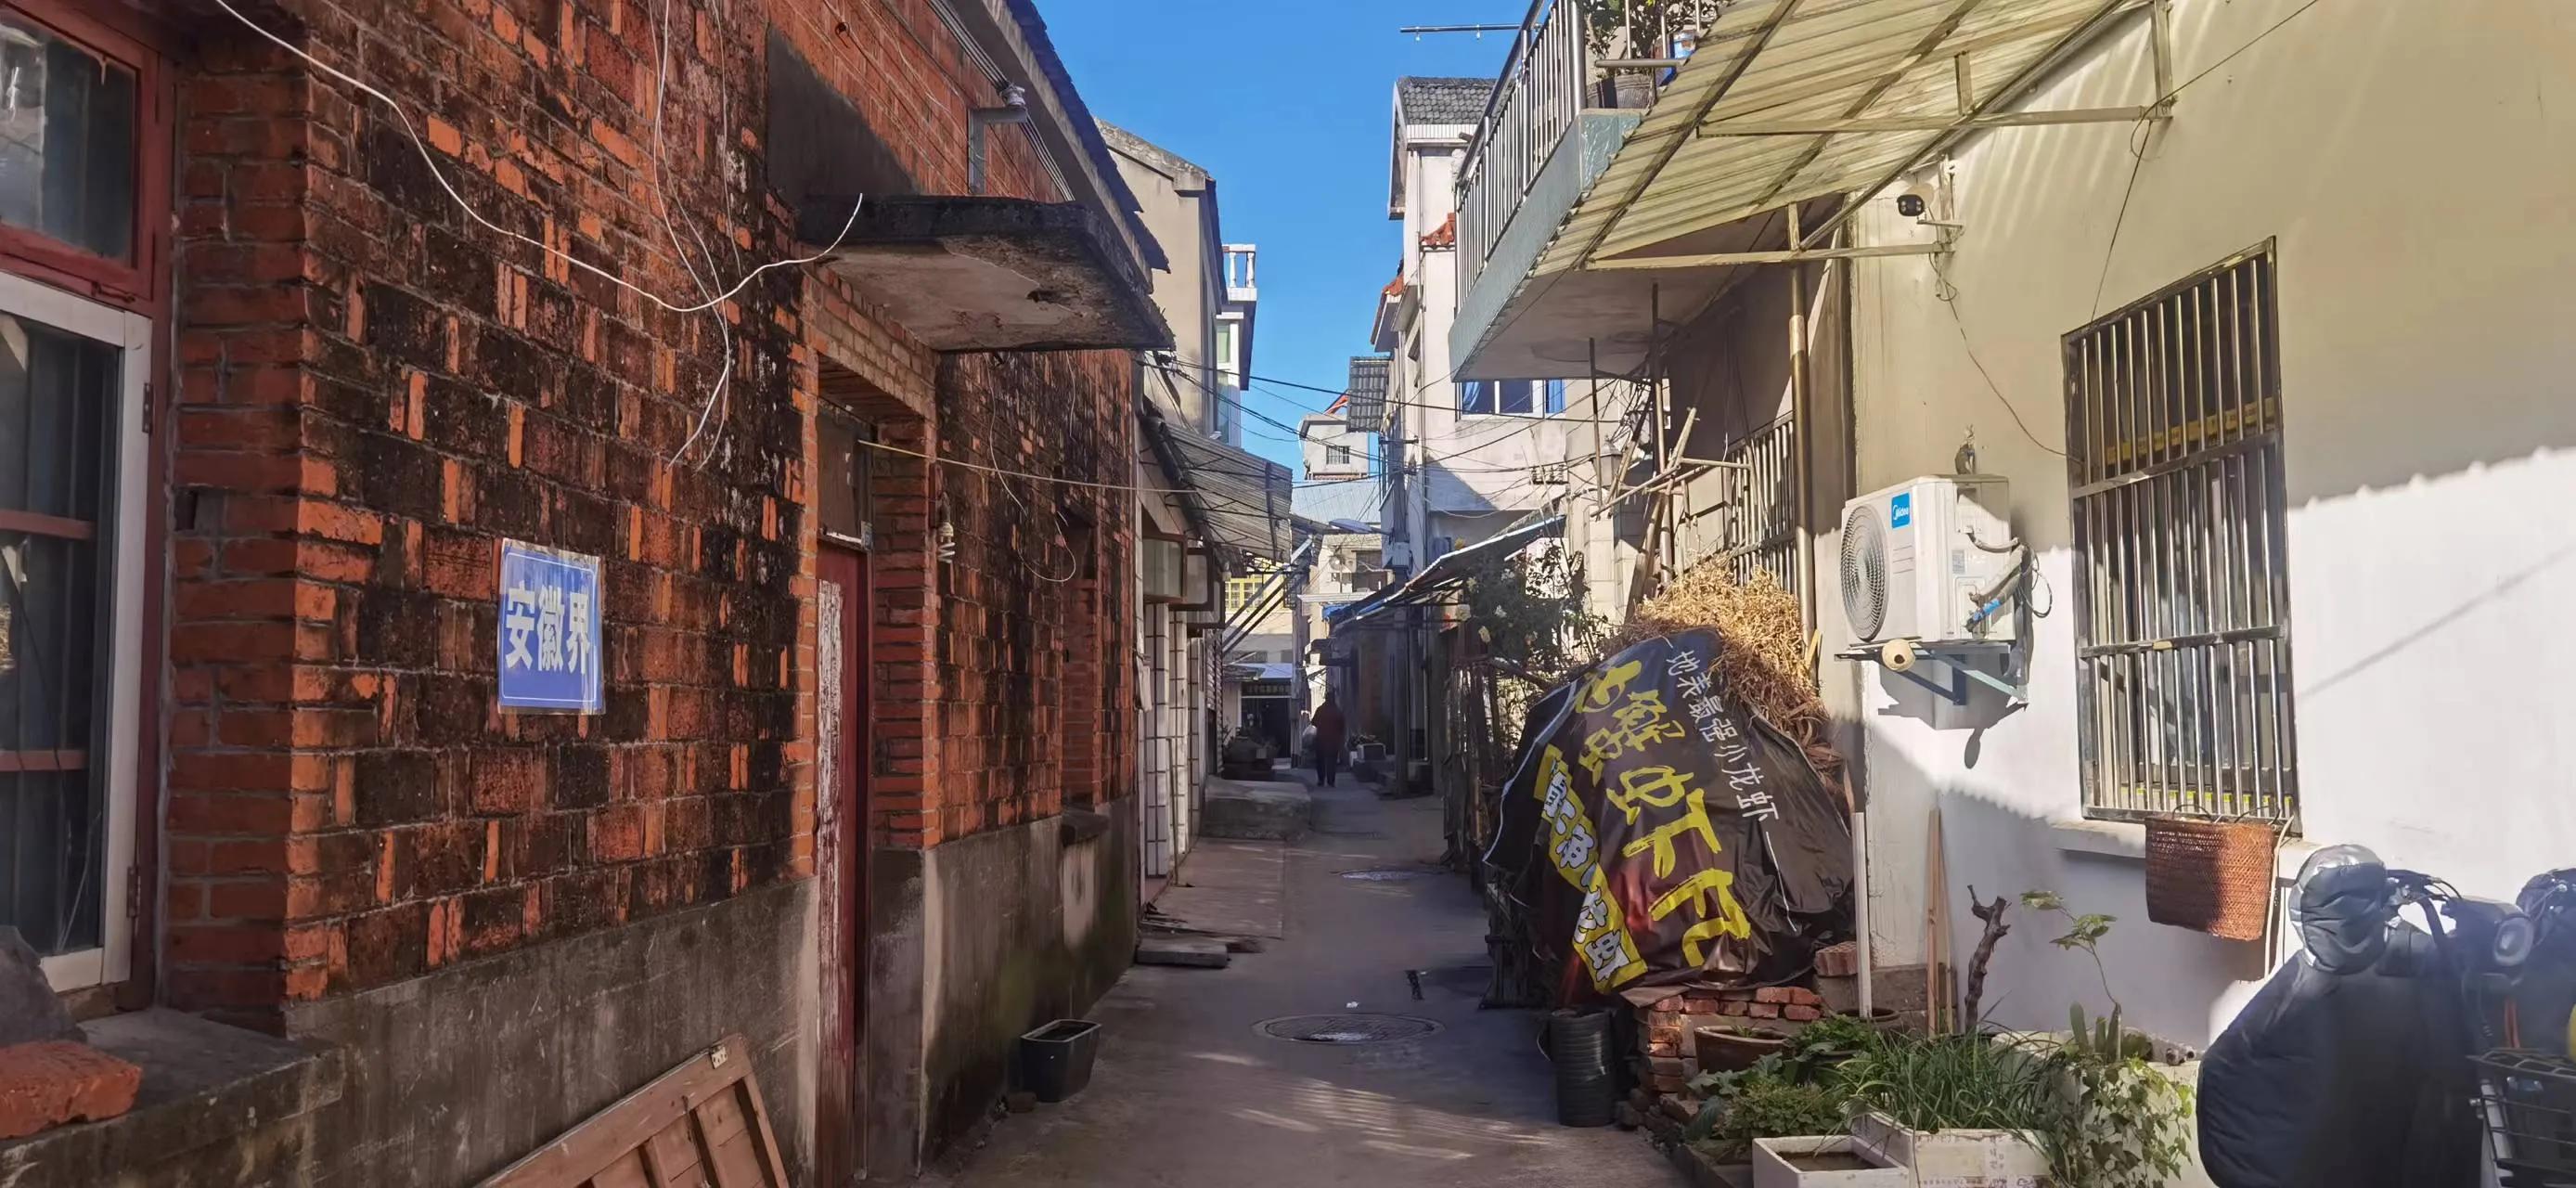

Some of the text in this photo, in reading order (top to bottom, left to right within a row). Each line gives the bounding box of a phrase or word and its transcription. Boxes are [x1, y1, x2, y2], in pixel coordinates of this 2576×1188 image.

[506, 580, 591, 675] 安徽界
[1667, 650, 1780, 821] 地表最强小龙虾
